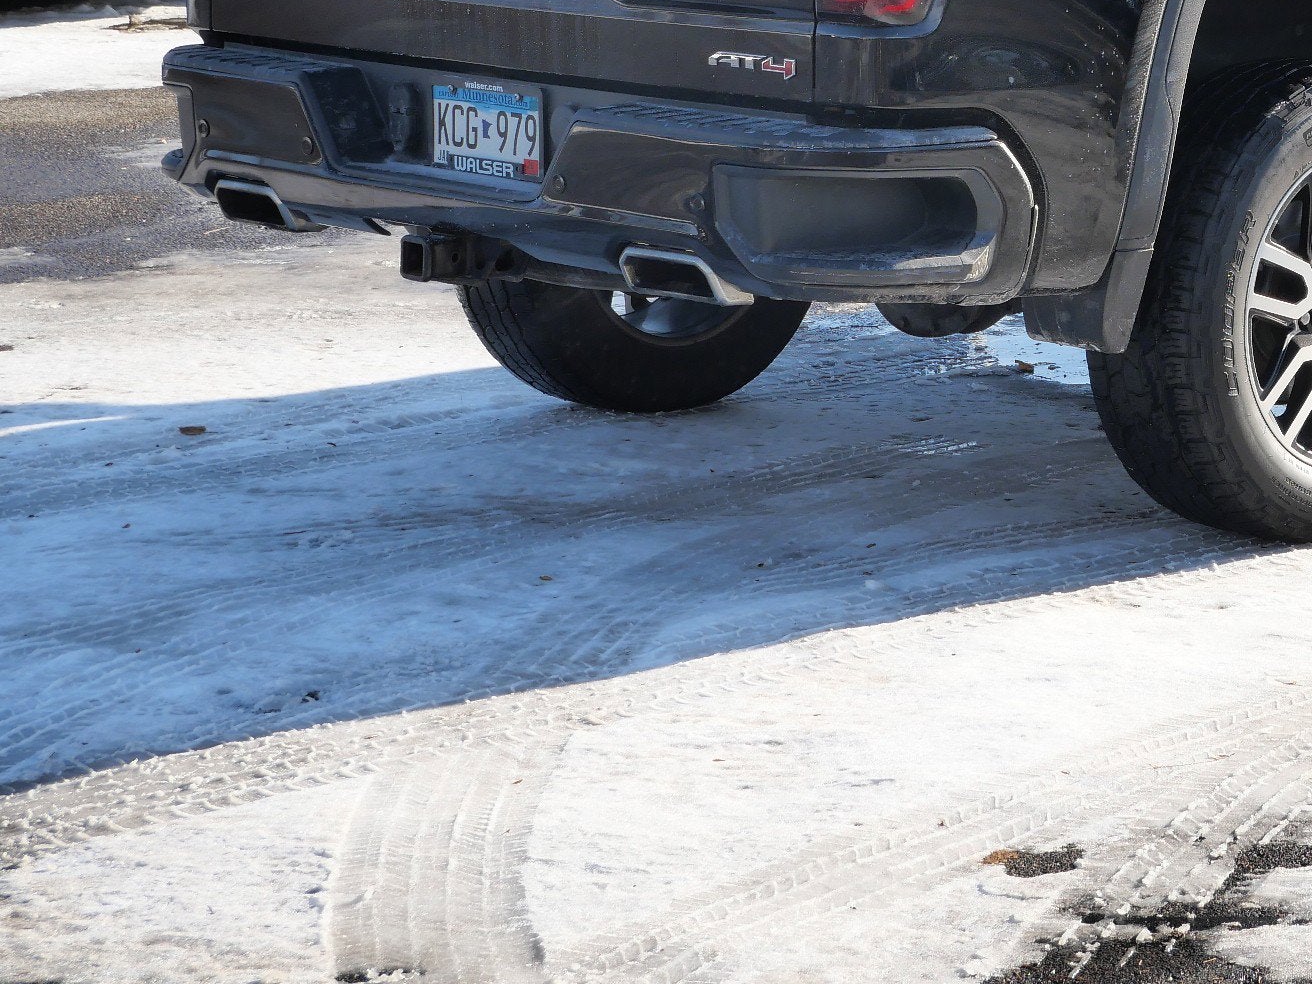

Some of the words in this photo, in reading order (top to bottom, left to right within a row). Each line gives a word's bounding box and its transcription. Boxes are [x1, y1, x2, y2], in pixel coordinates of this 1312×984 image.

[708, 51, 796, 80] AT4
[464, 81, 504, 92] walser.com
[437, 102, 479, 150] KCG
[496, 110, 537, 157] 979
[454, 155, 514, 178] WALSER
